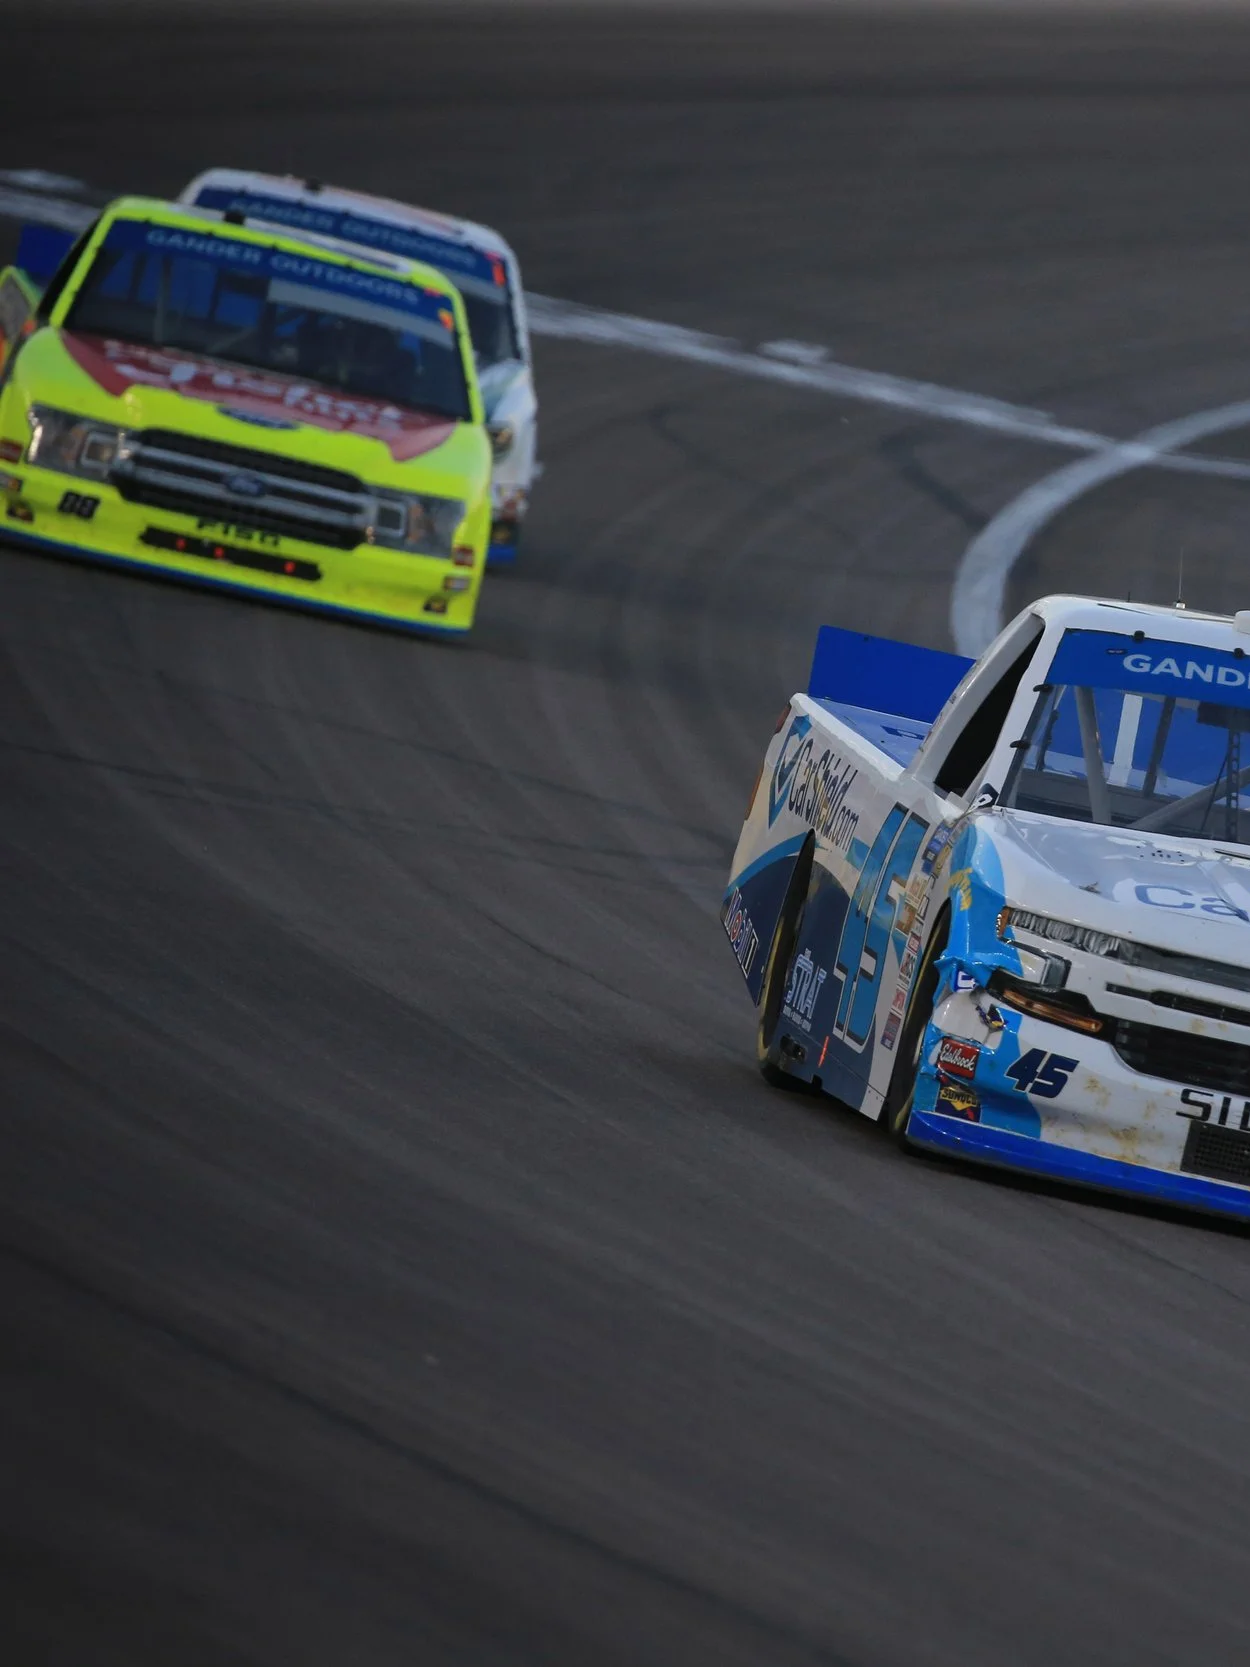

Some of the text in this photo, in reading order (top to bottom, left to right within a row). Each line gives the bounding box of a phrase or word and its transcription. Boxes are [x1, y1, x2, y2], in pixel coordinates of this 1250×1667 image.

[147, 229, 419, 304] GANDER OUTDOORS
[1004, 1048, 1080, 1099] 45
